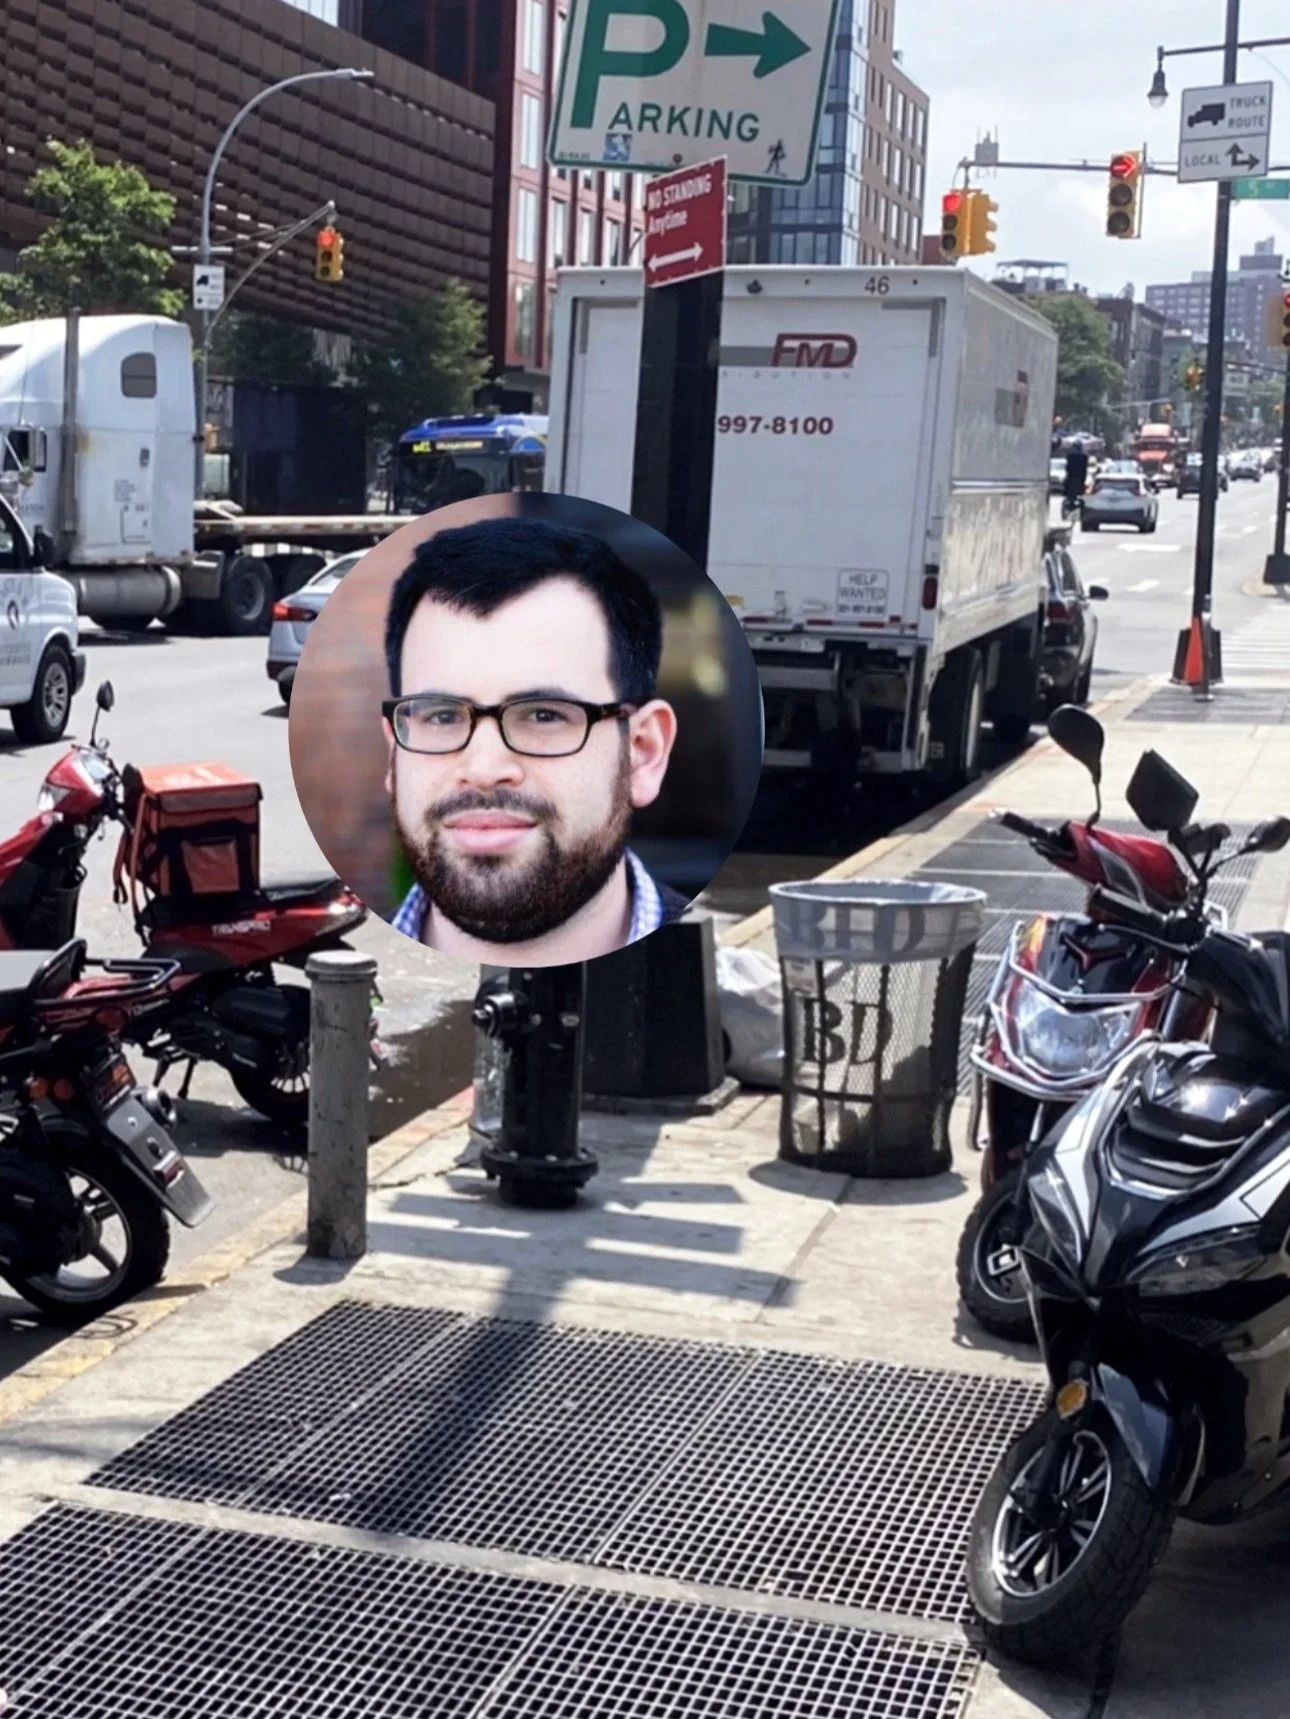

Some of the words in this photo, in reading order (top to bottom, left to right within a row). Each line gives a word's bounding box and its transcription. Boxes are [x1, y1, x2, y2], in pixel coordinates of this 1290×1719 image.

[1229, 95, 1266, 109] TRUCK
[1227, 115, 1265, 128] ROUTE
[1184, 153, 1221, 168] LOCAL
[648, 189, 662, 211] NO
[663, 173, 712, 206] STANDING
[649, 210, 687, 236] Anytime
[864, 275, 890, 296] 46
[771, 333, 858, 369] FMD
[717, 415, 834, 436] 997-8100
[849, 573, 878, 585] HELP
[839, 587, 886, 600] WANTED
